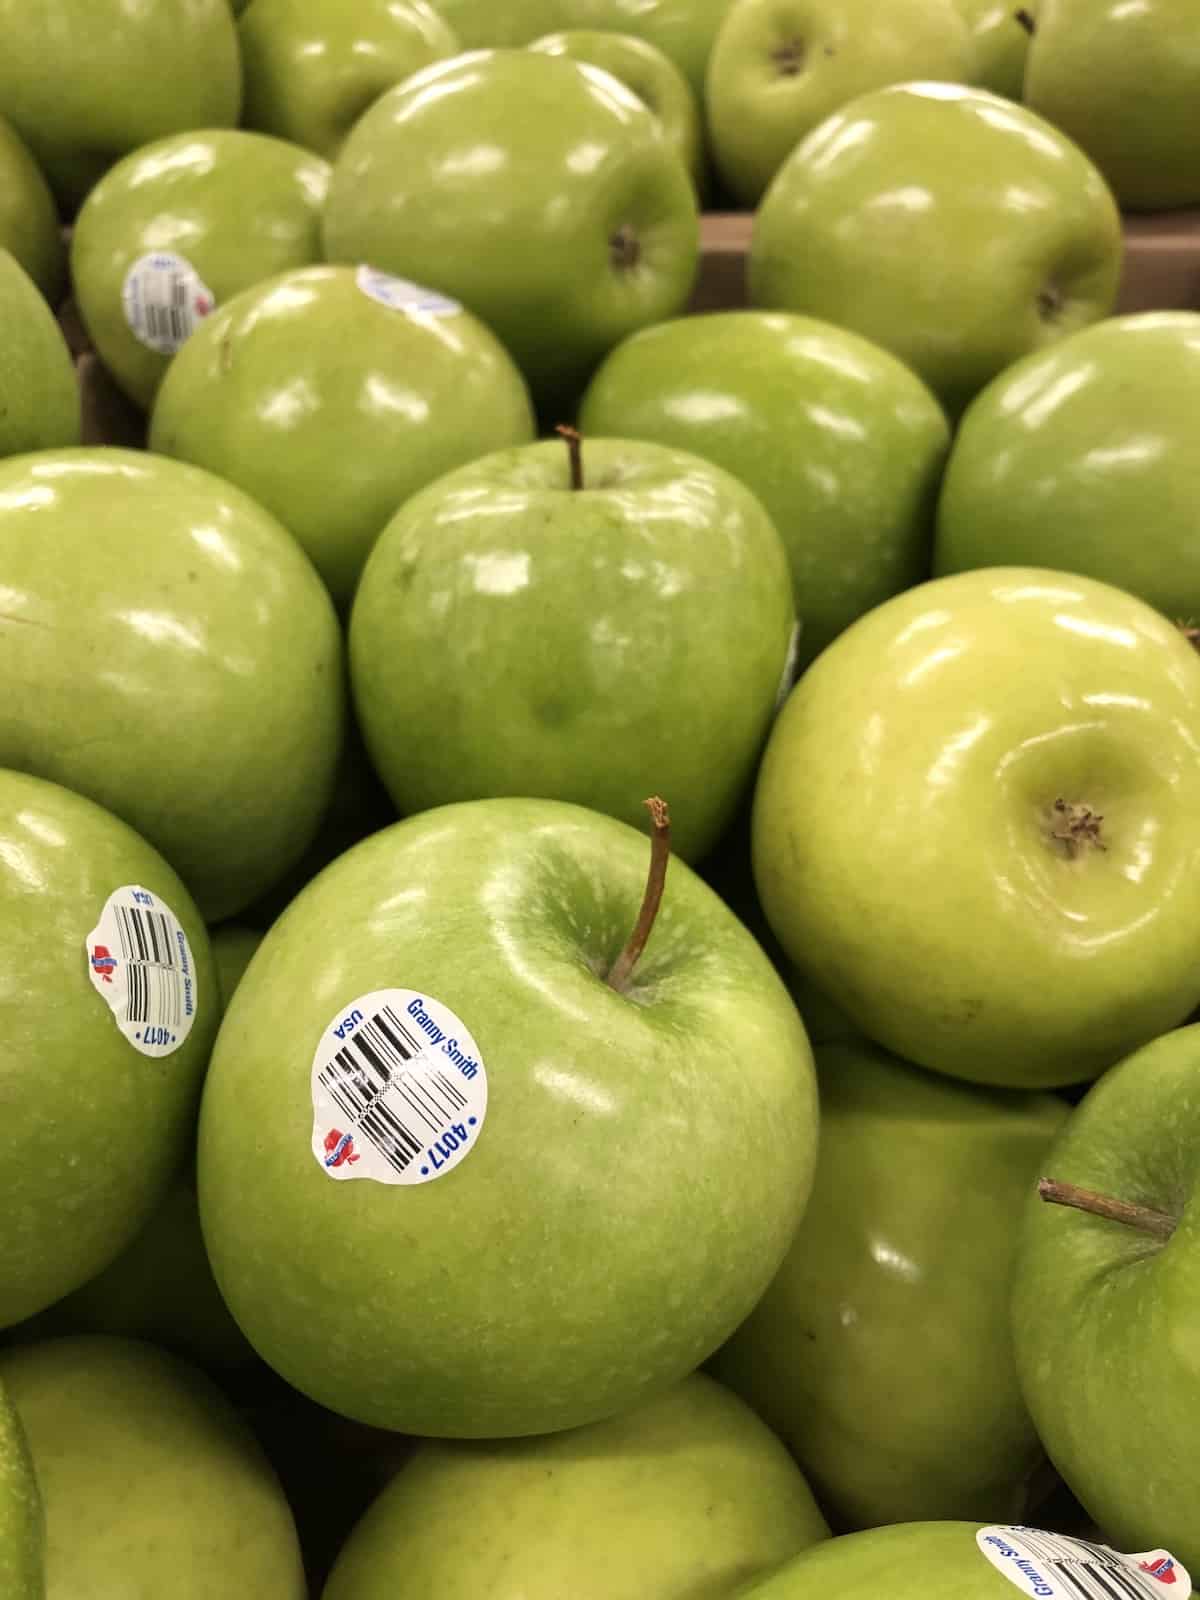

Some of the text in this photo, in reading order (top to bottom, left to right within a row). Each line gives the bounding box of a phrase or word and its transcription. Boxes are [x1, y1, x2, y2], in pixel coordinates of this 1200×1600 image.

[143, 1026, 170, 1045] 4017
[333, 1009, 364, 1040] USA
[406, 998, 479, 1080] Granny Smith
[427, 1122, 469, 1170] 4017
[1014, 1558, 1054, 1597] Granny
